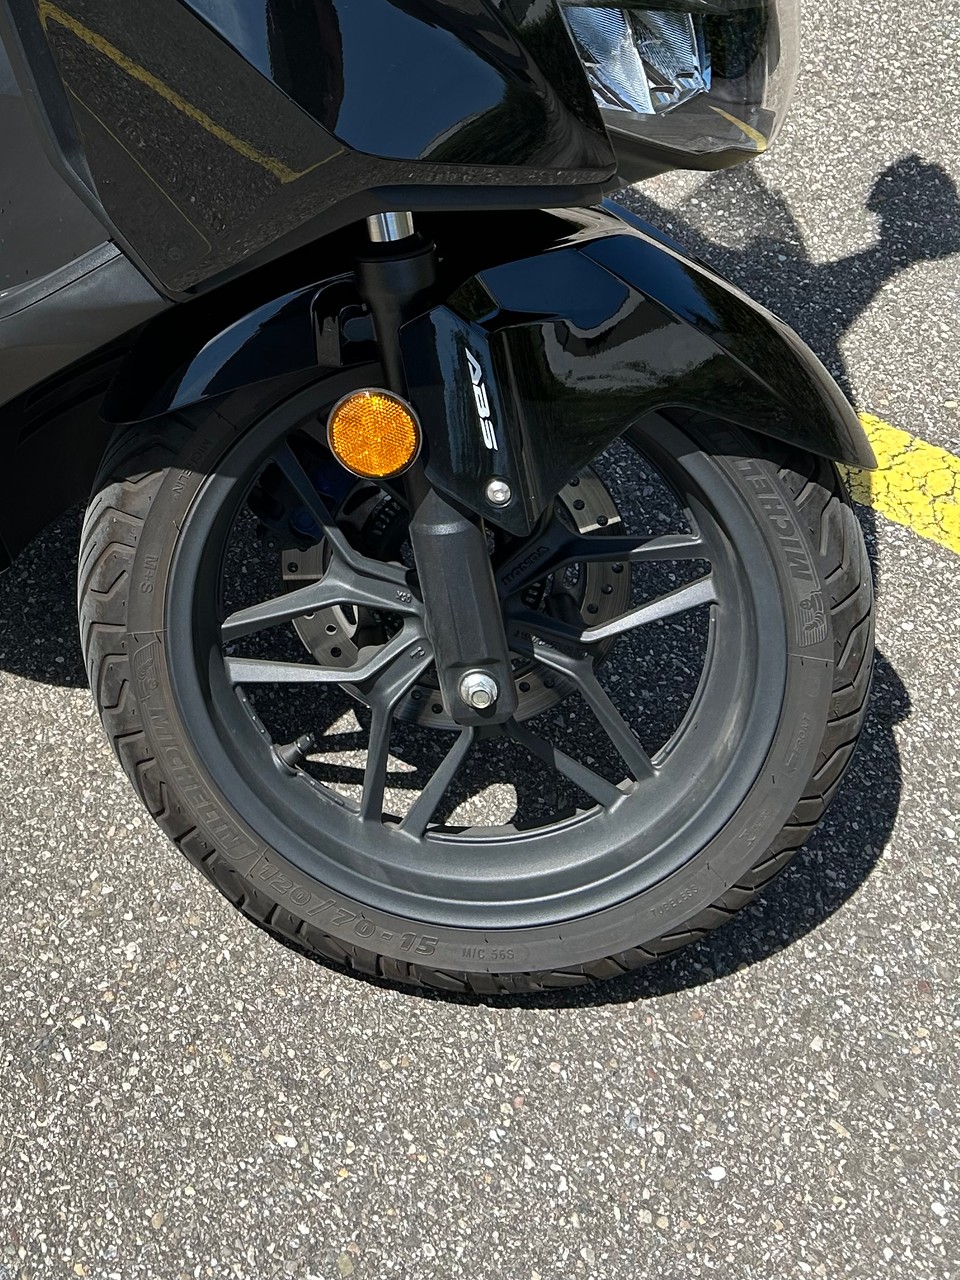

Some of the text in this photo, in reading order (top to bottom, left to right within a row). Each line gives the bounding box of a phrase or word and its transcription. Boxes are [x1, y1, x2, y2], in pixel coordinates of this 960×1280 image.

[465, 347, 499, 451] ABS
[141, 554, 159, 593] M+S
[147, 706, 246, 851] MICHELIN
[650, 884, 699, 917] TUBELESS
[462, 947, 485, 960] M/C
[491, 949, 515, 960] 56S
